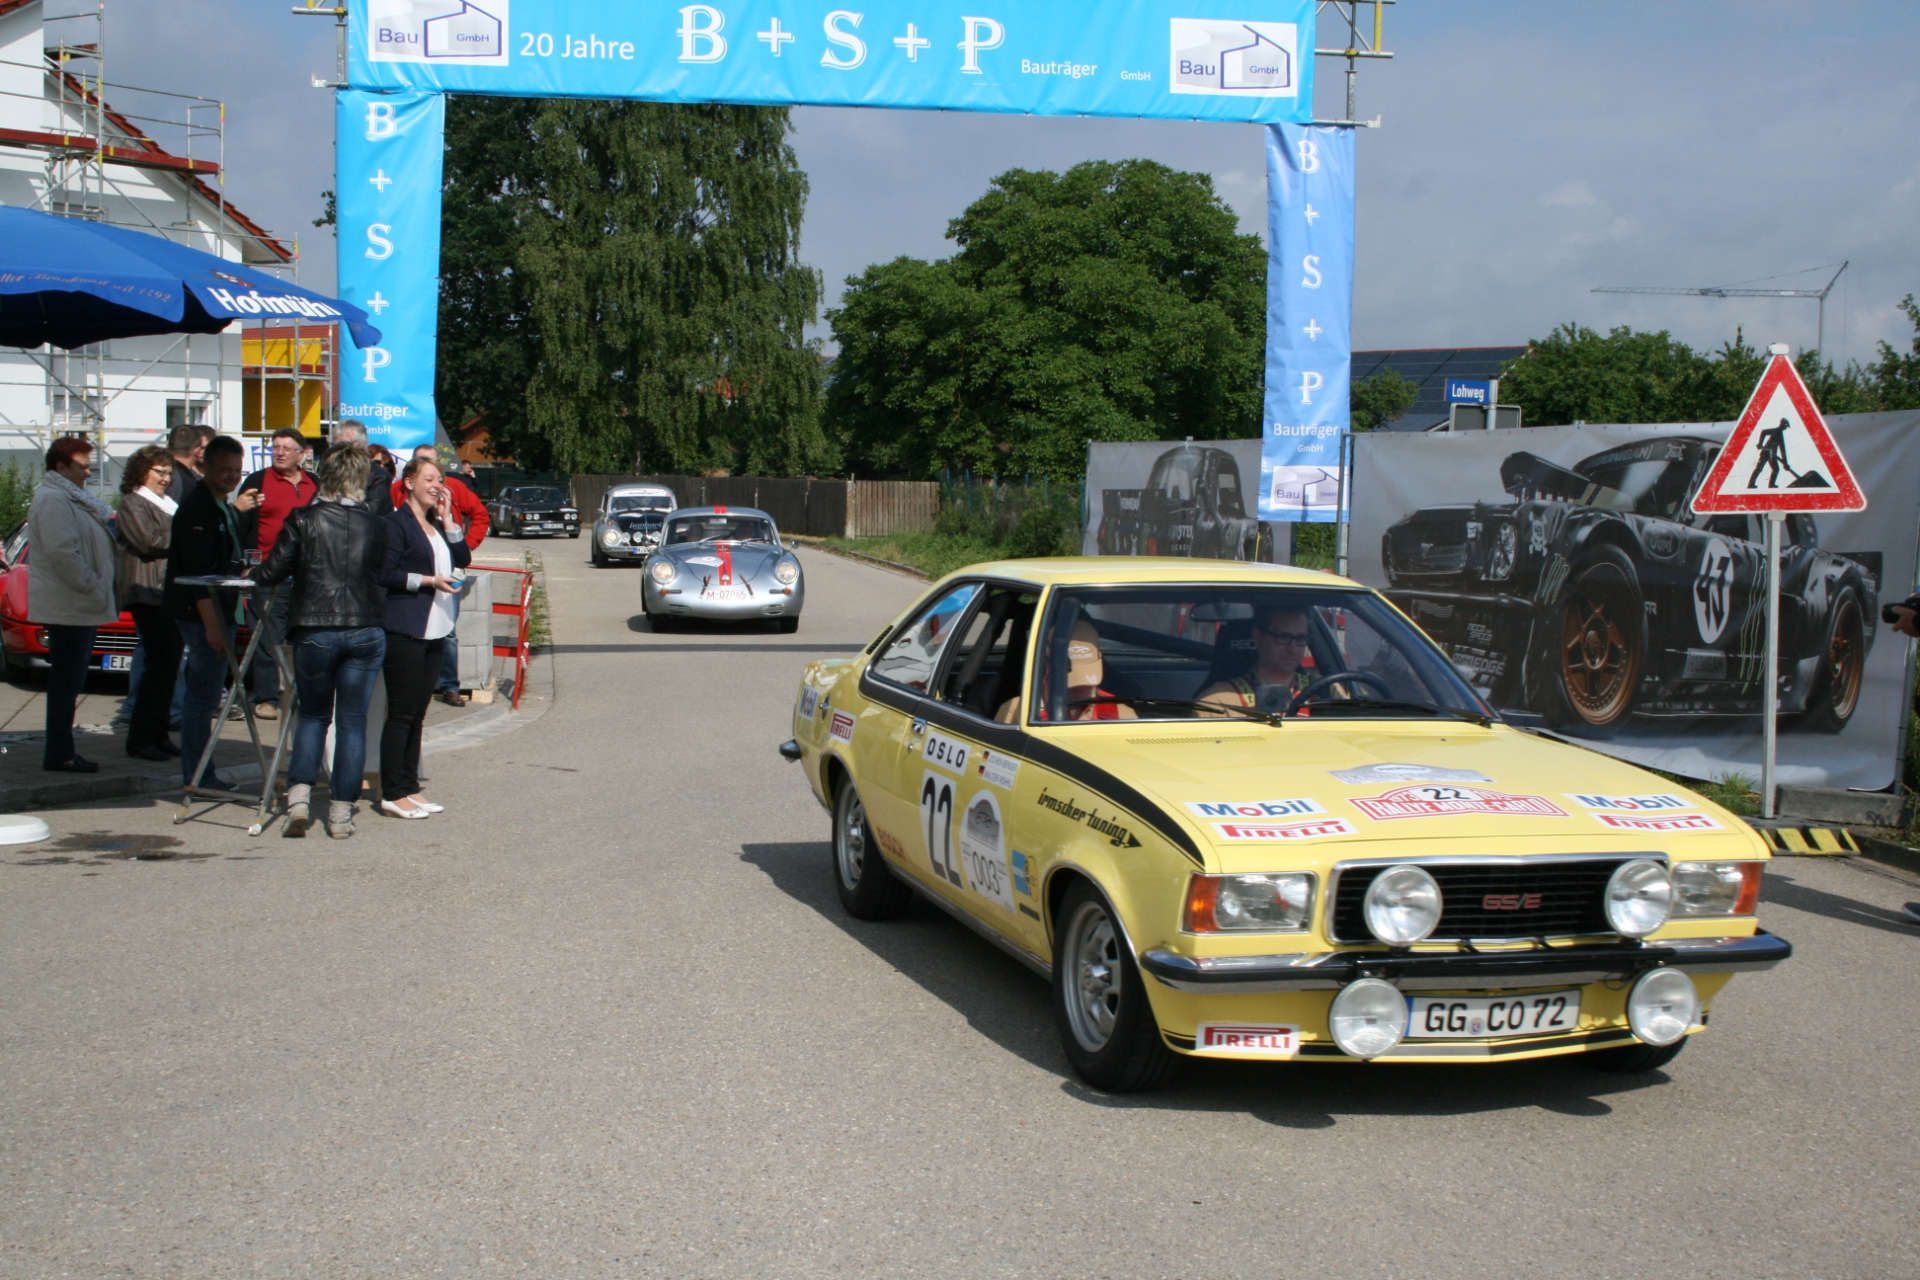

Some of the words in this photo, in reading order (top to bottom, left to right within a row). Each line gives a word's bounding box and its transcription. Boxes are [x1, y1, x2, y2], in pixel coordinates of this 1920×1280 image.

[379, 27, 419, 44] Bau
[456, 33, 490, 42] GmbH
[676, 4, 728, 64] B
[820, 9, 868, 71] S
[957, 15, 1005, 75] P
[520, 32, 554, 57] 20
[561, 34, 635, 60] Jahre
[1020, 58, 1098, 79] Bauträger
[1120, 71, 1151, 81] GmbH
[1180, 60, 1216, 76] Bau
[1249, 65, 1279, 75] GmbH
[365, 101, 396, 142] B
[1297, 140, 1320, 174] B
[364, 223, 394, 261] S
[1301, 255, 1322, 288] S
[207, 287, 342, 317] Hofmühl
[361, 346, 392, 384] P
[1299, 371, 1324, 405] P
[1451, 383, 1485, 402] Lohweg
[340, 402, 409, 419] Bauträger
[365, 425, 392, 434] mbH
[1273, 423, 1338, 439] Bauträger
[1296, 443, 1324, 453] GmbH
[1276, 488, 1300, 500] Bau
[927, 737, 966, 769] OSLO
[1421, 788, 1471, 800] 22
[1576, 795, 1684, 810] Mobil
[1037, 786, 1088, 822] irmscher
[1086, 808, 1128, 848] tuning
[1198, 800, 1313, 816] Mobil
[922, 776, 963, 889] 22
[1221, 820, 1347, 838] PIRELLI
[1599, 815, 1713, 830] PIRELLI
[1425, 1003, 1468, 1032] GG
[1534, 997, 1566, 1028] 72
[1204, 1027, 1291, 1049] PIRELLI
